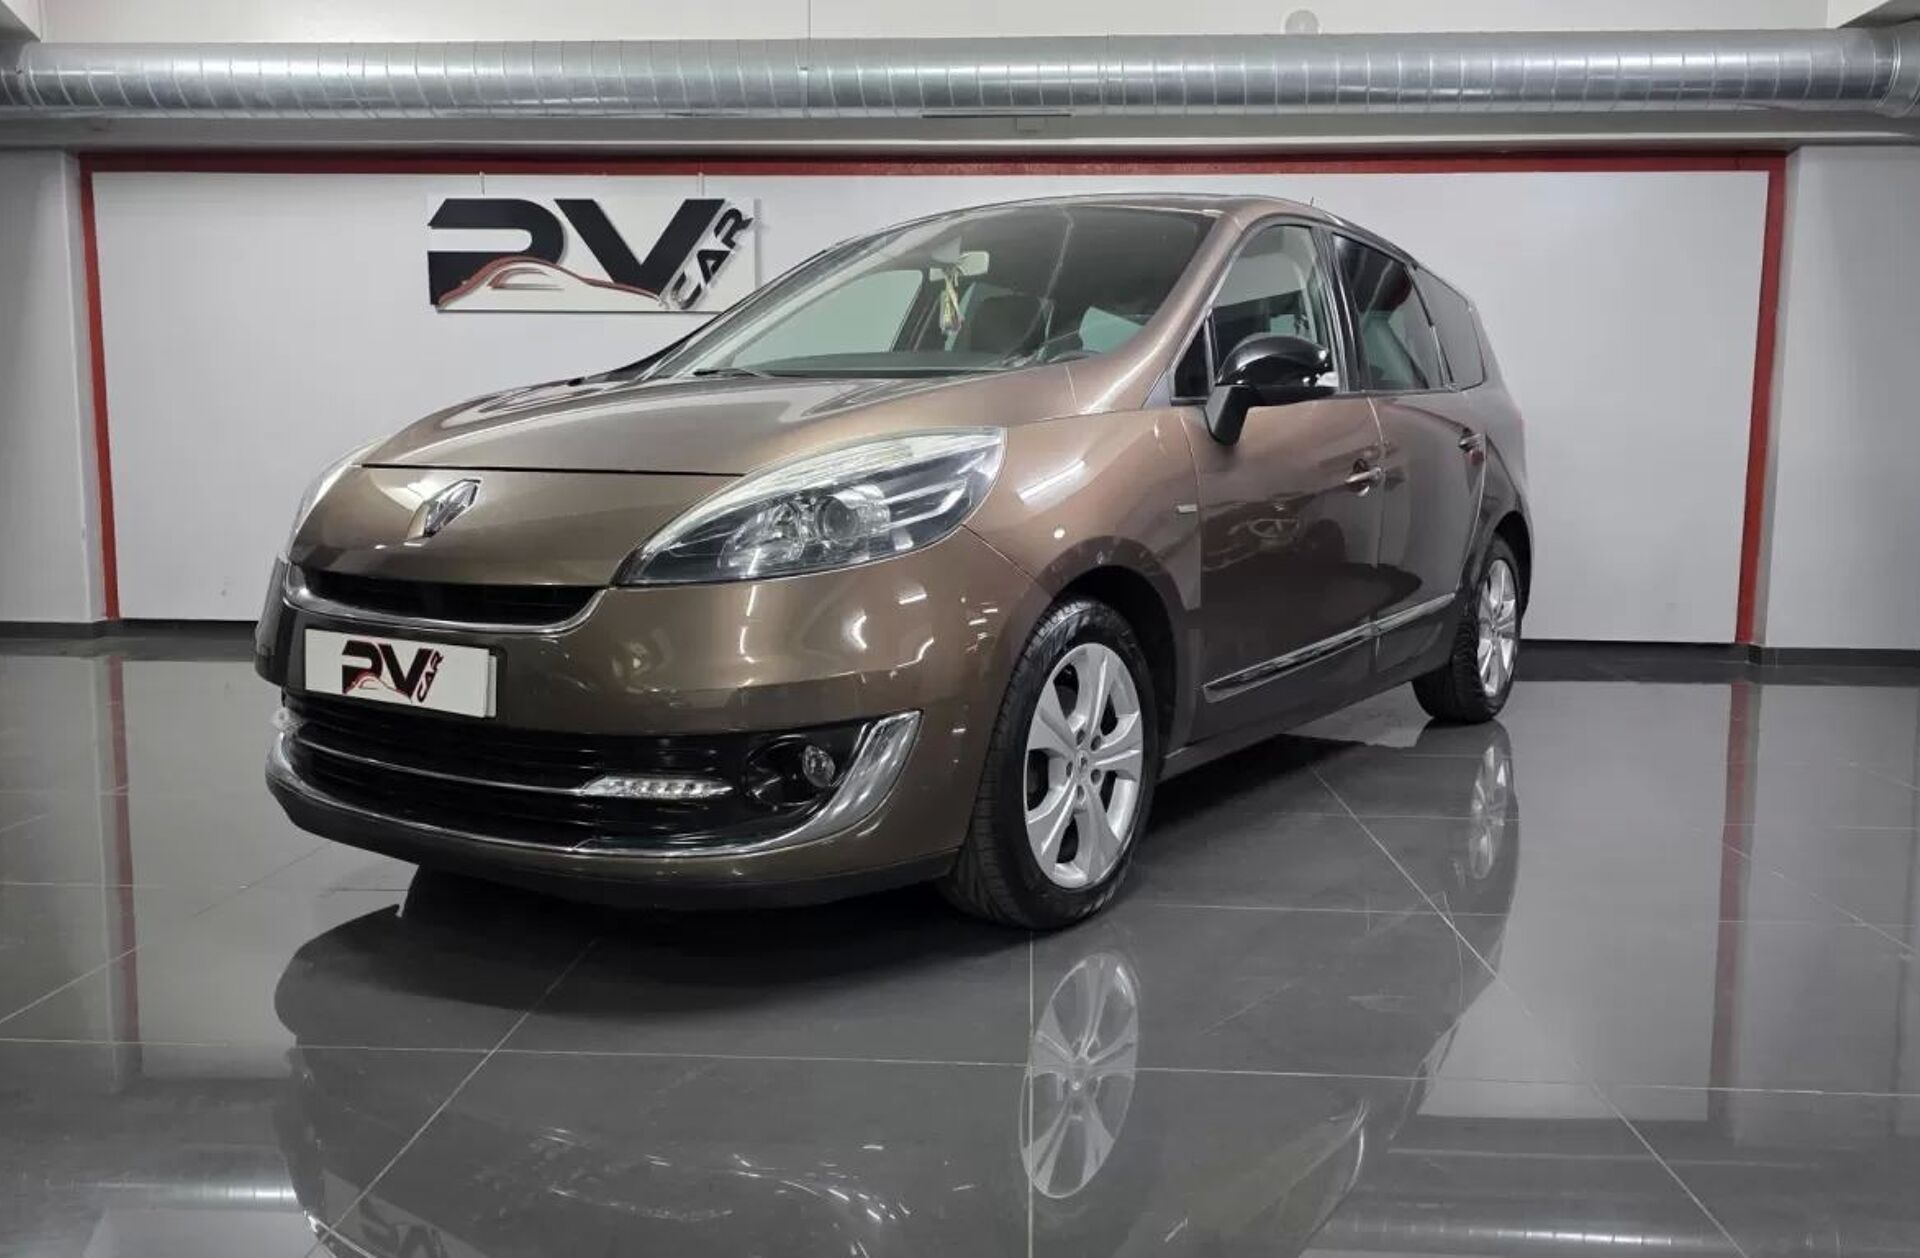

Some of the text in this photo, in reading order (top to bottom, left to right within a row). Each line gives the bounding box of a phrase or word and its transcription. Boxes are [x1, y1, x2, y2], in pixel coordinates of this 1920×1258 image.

[427, 198, 754, 310] PV CAR
[342, 640, 444, 703] PV CAR
